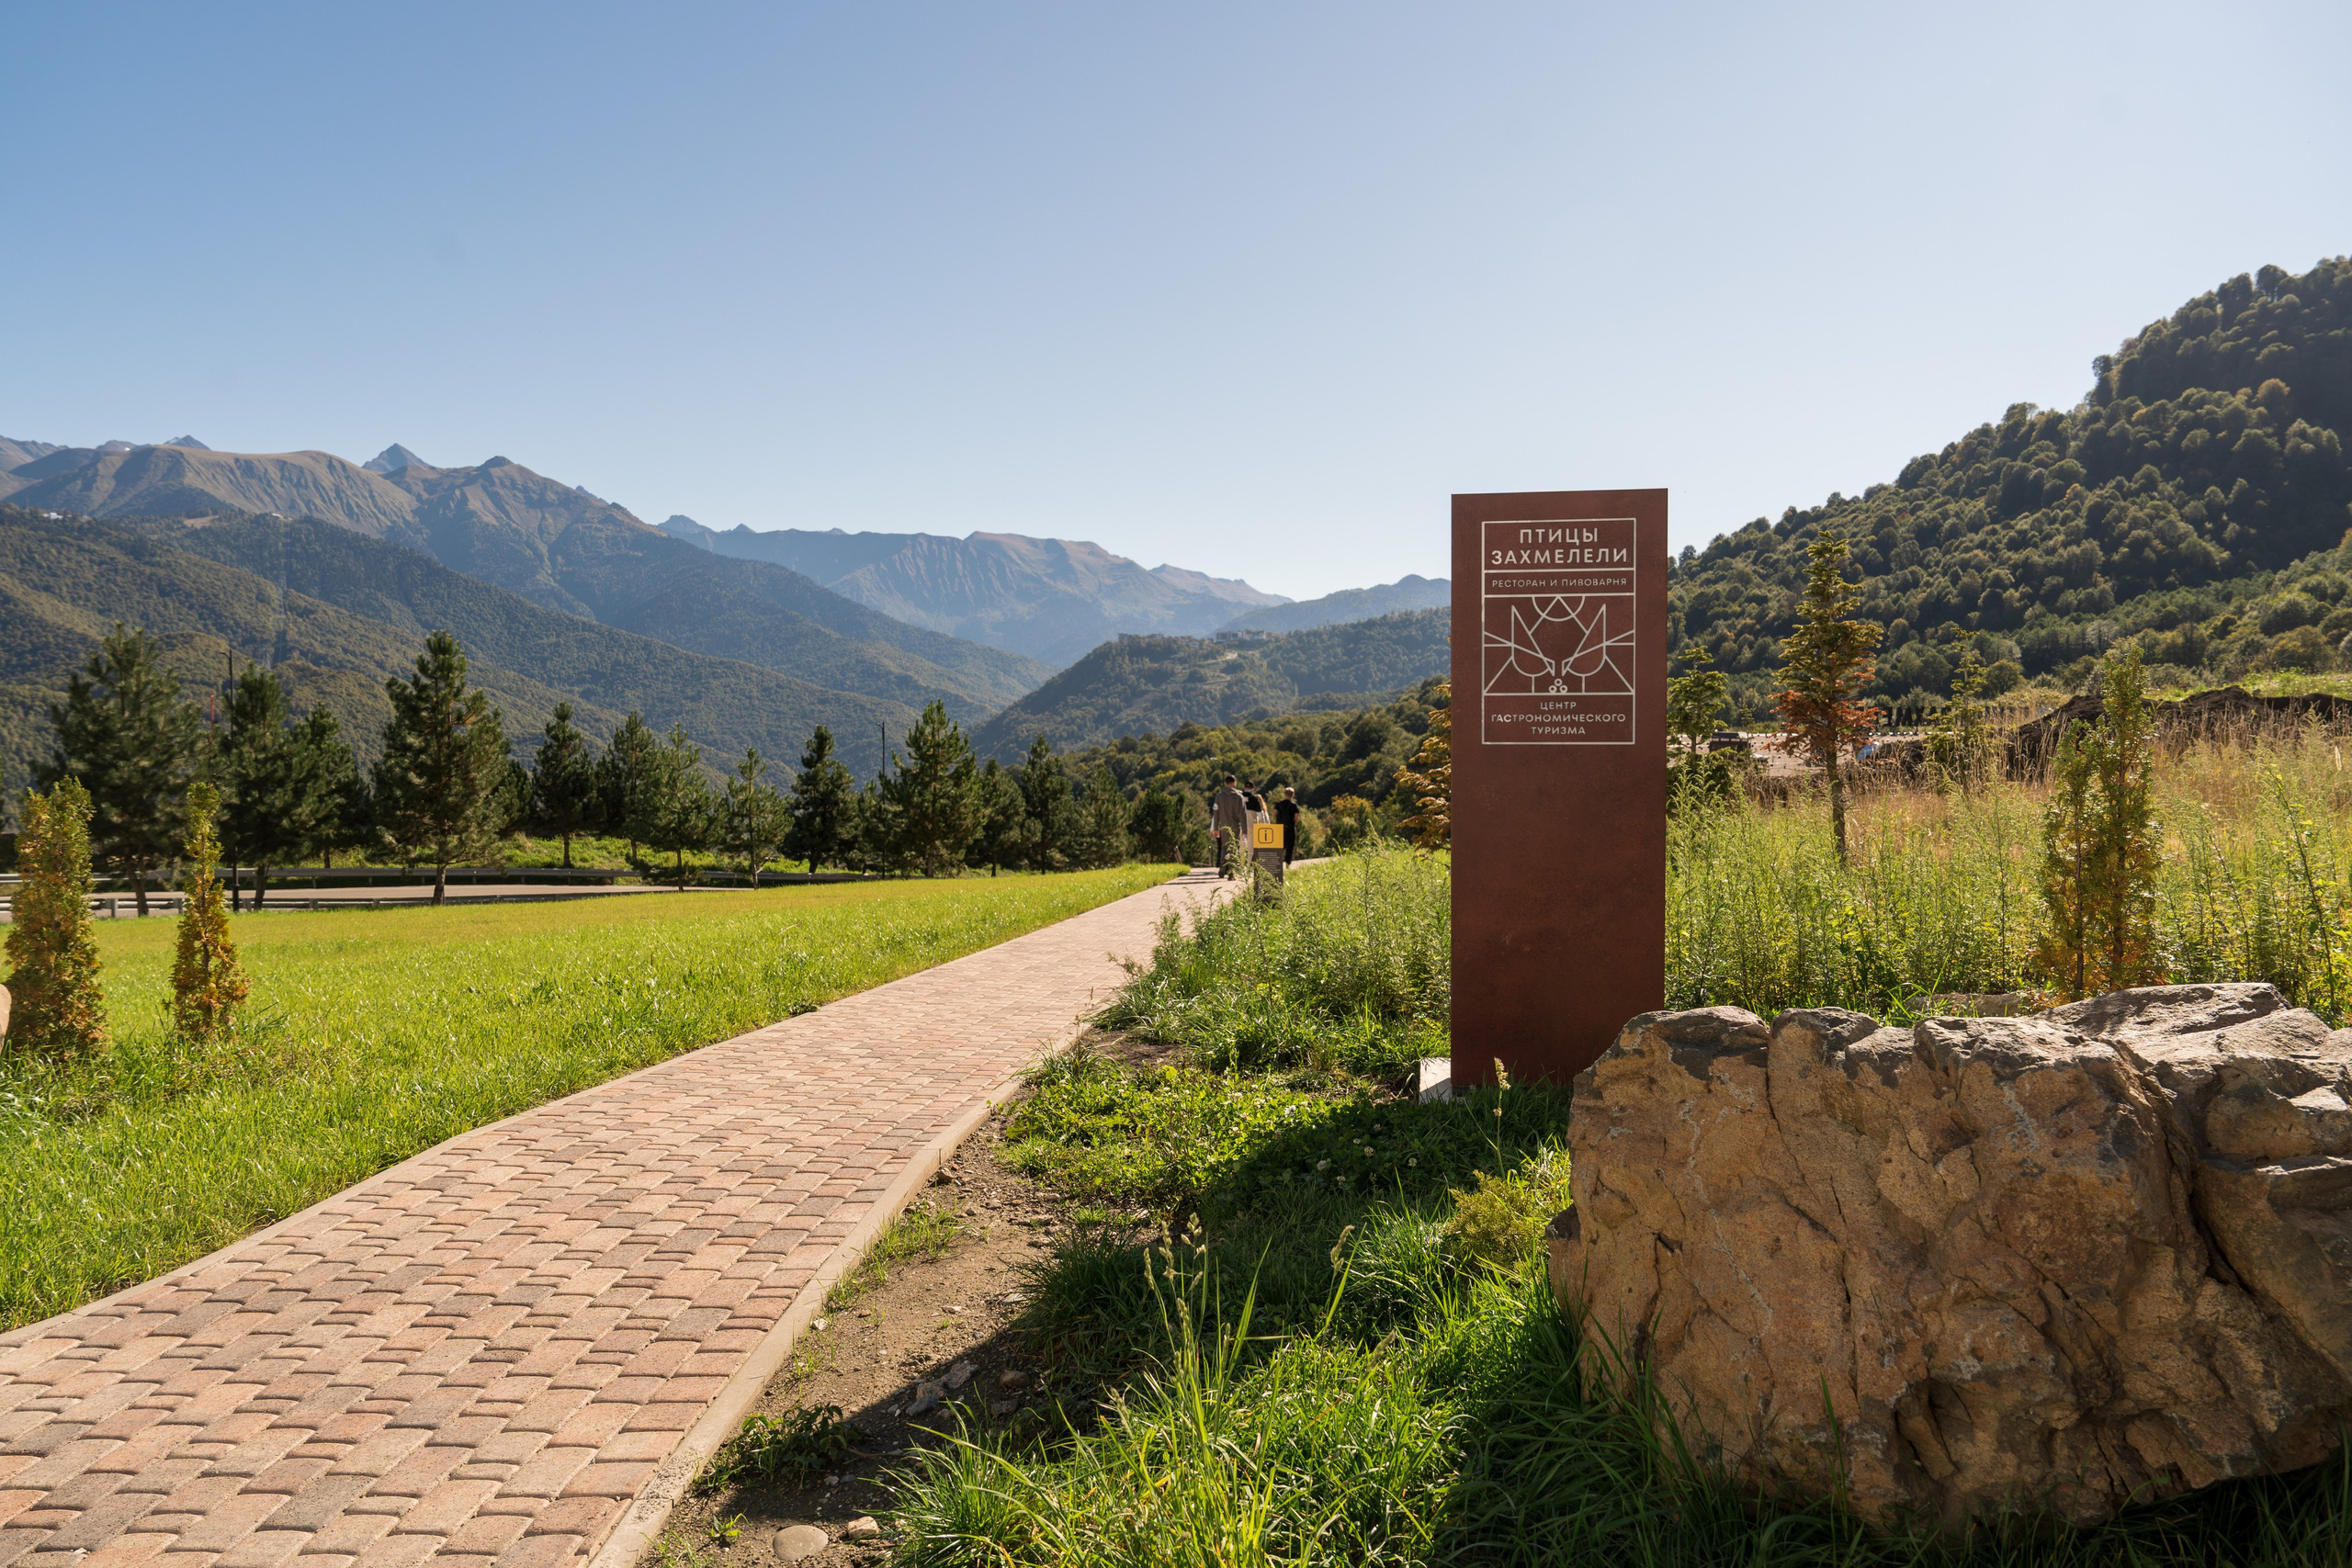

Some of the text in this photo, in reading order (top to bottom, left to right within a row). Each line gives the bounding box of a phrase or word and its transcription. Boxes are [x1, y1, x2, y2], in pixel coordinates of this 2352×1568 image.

[1519, 527, 1598, 546] ПТИЦЫ
[1491, 547, 1628, 565] ЗАХМЕЛЕЛИ
[1492, 578, 1627, 588] РЕСТОРАН И ПИВОВАРНЯ
[1540, 701, 1577, 711] ЦЕНТР
[1491, 714, 1626, 723] ГАСТРОНОМИЧЕСКОГО
[1531, 726, 1586, 735] ТУРИЗМА
